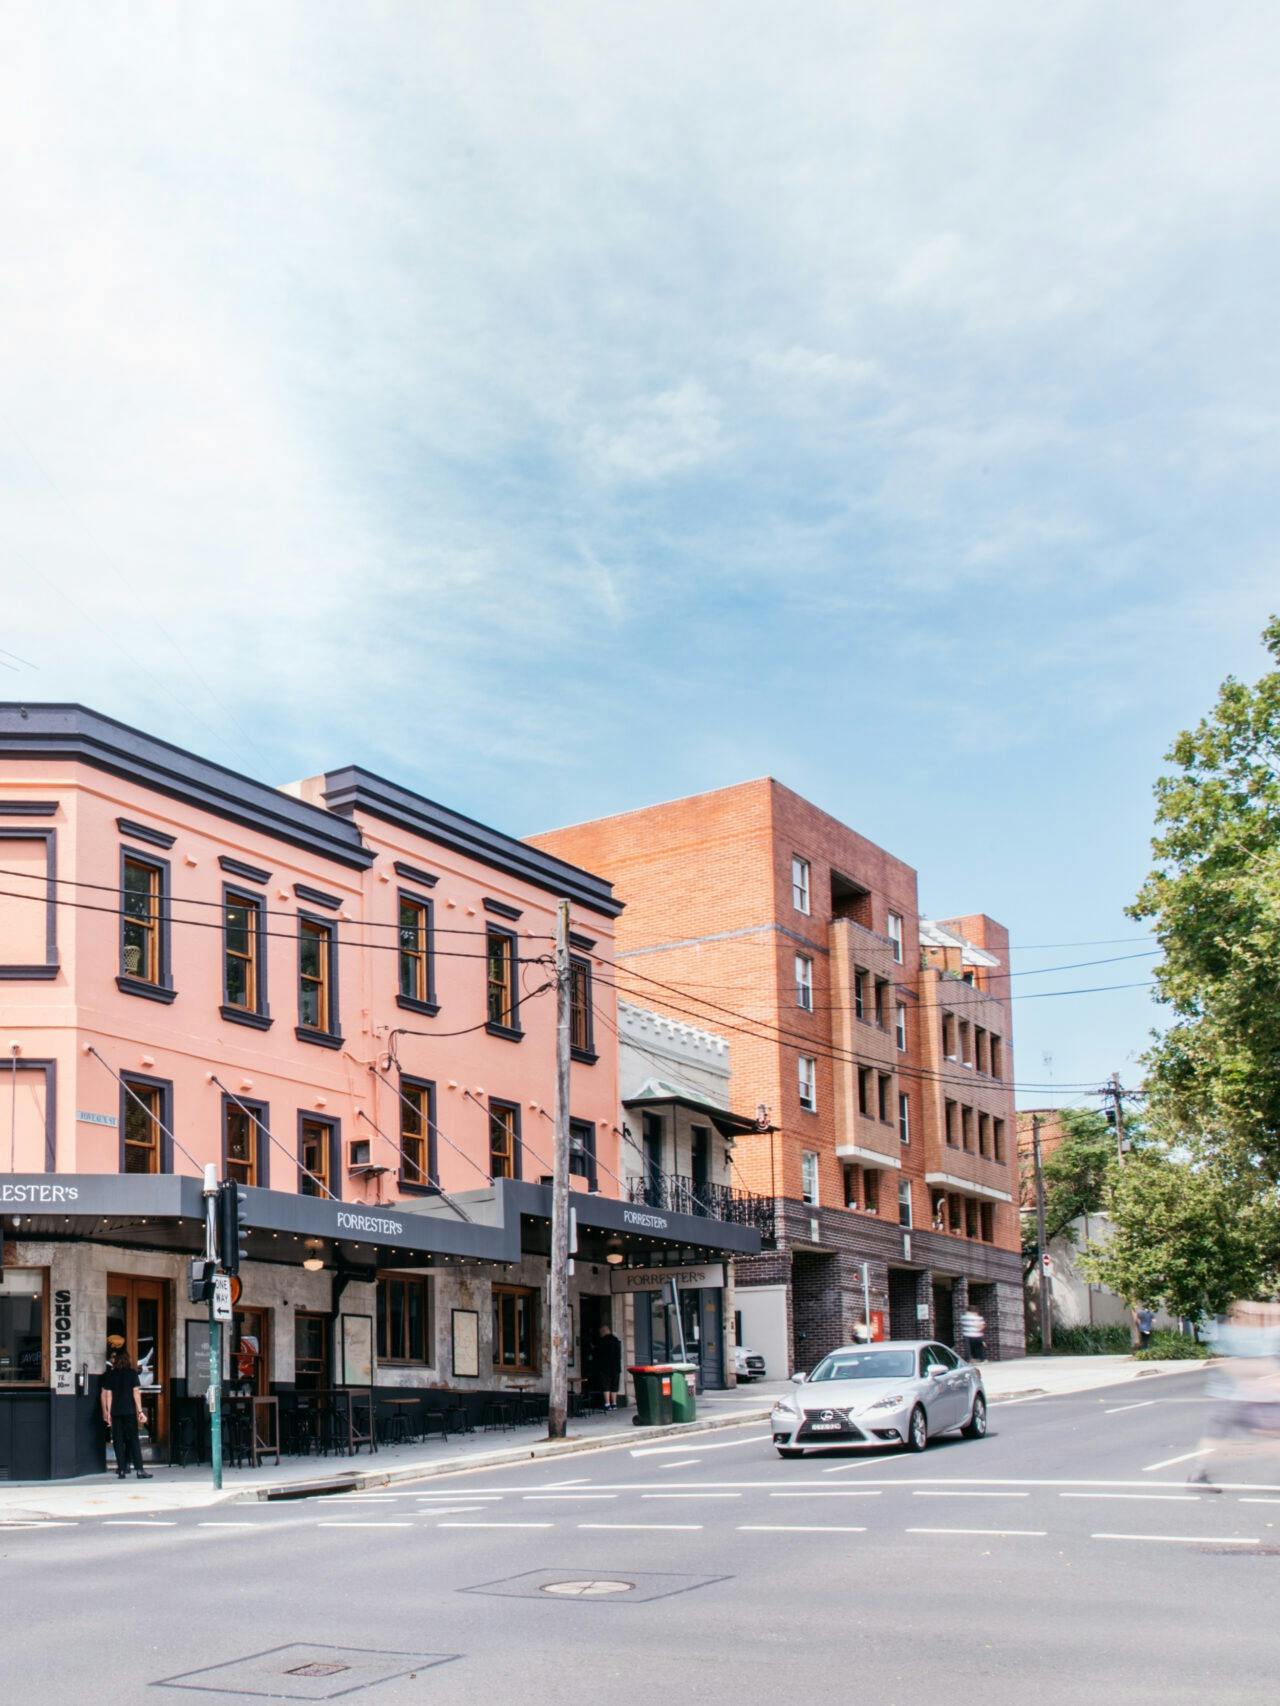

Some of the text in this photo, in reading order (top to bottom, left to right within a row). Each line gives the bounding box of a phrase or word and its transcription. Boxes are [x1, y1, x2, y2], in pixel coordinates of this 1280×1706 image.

[215, 1279, 228, 1290] ONE
[215, 1293, 228, 1303] WAY
[55, 1290, 72, 1373] SHOPPE
